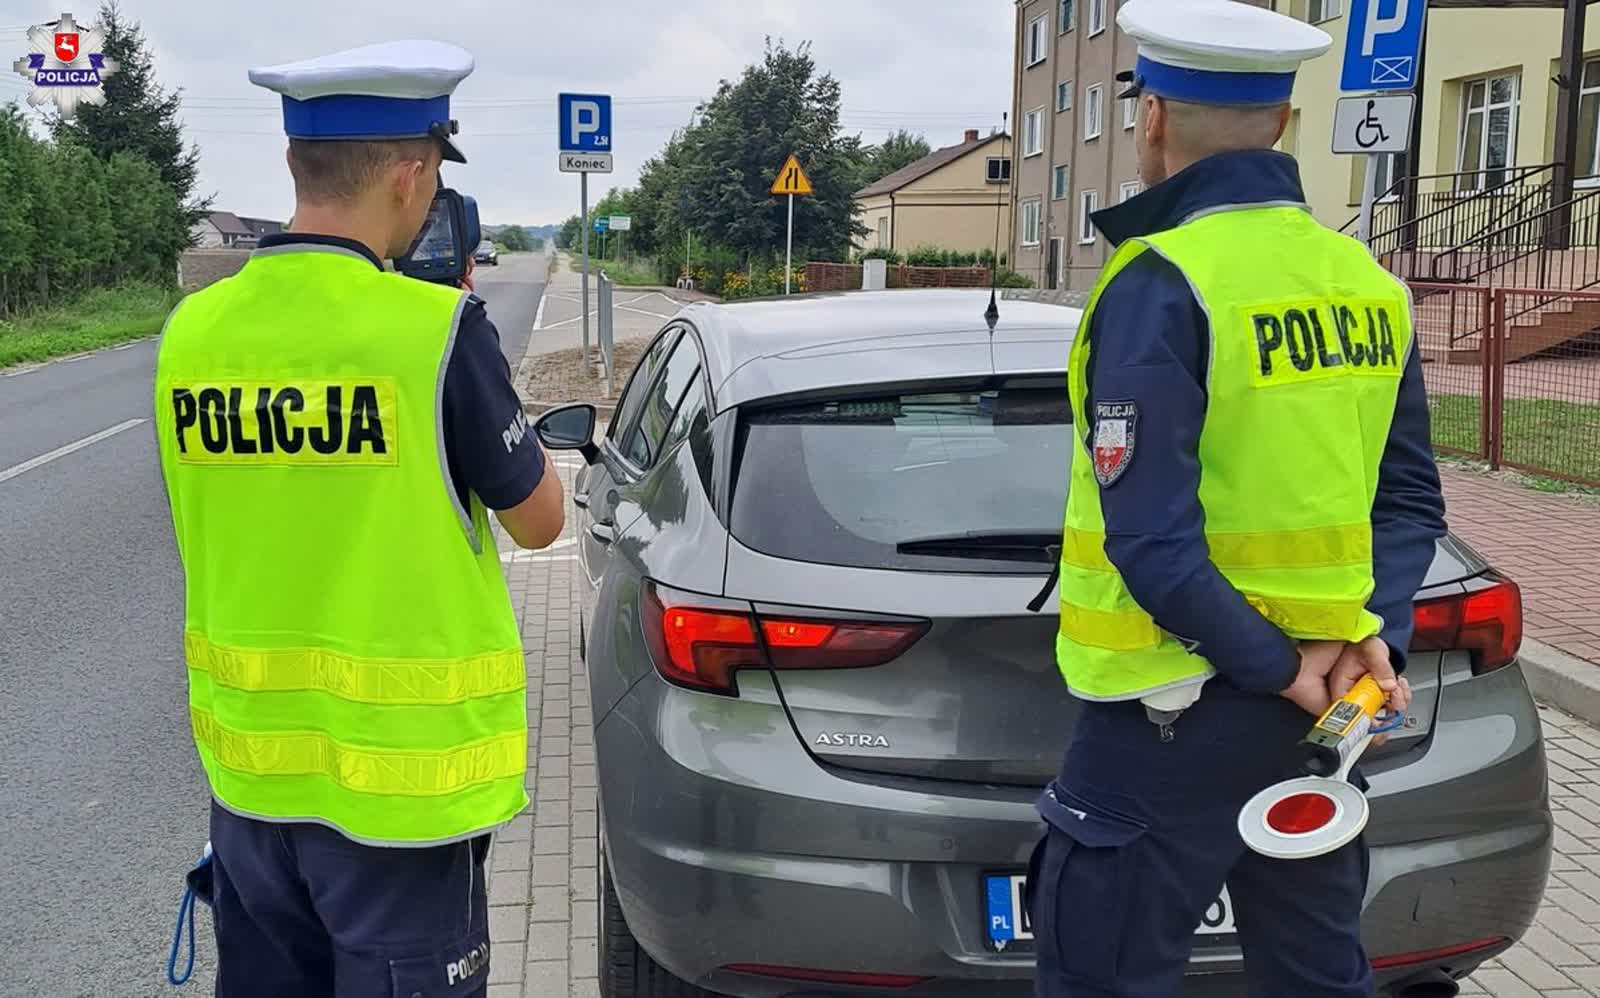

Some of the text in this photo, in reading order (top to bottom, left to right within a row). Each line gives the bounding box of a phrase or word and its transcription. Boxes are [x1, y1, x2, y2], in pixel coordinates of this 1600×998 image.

[1362, 0, 1408, 56] P
[571, 101, 600, 145] P
[566, 157, 606, 168] Koniec
[1252, 304, 1397, 377] POLICJA
[172, 386, 387, 454] POLICJA
[1097, 405, 1135, 417] POLICJA
[816, 733, 889, 747] ASTRA
[992, 915, 1010, 930] PL
